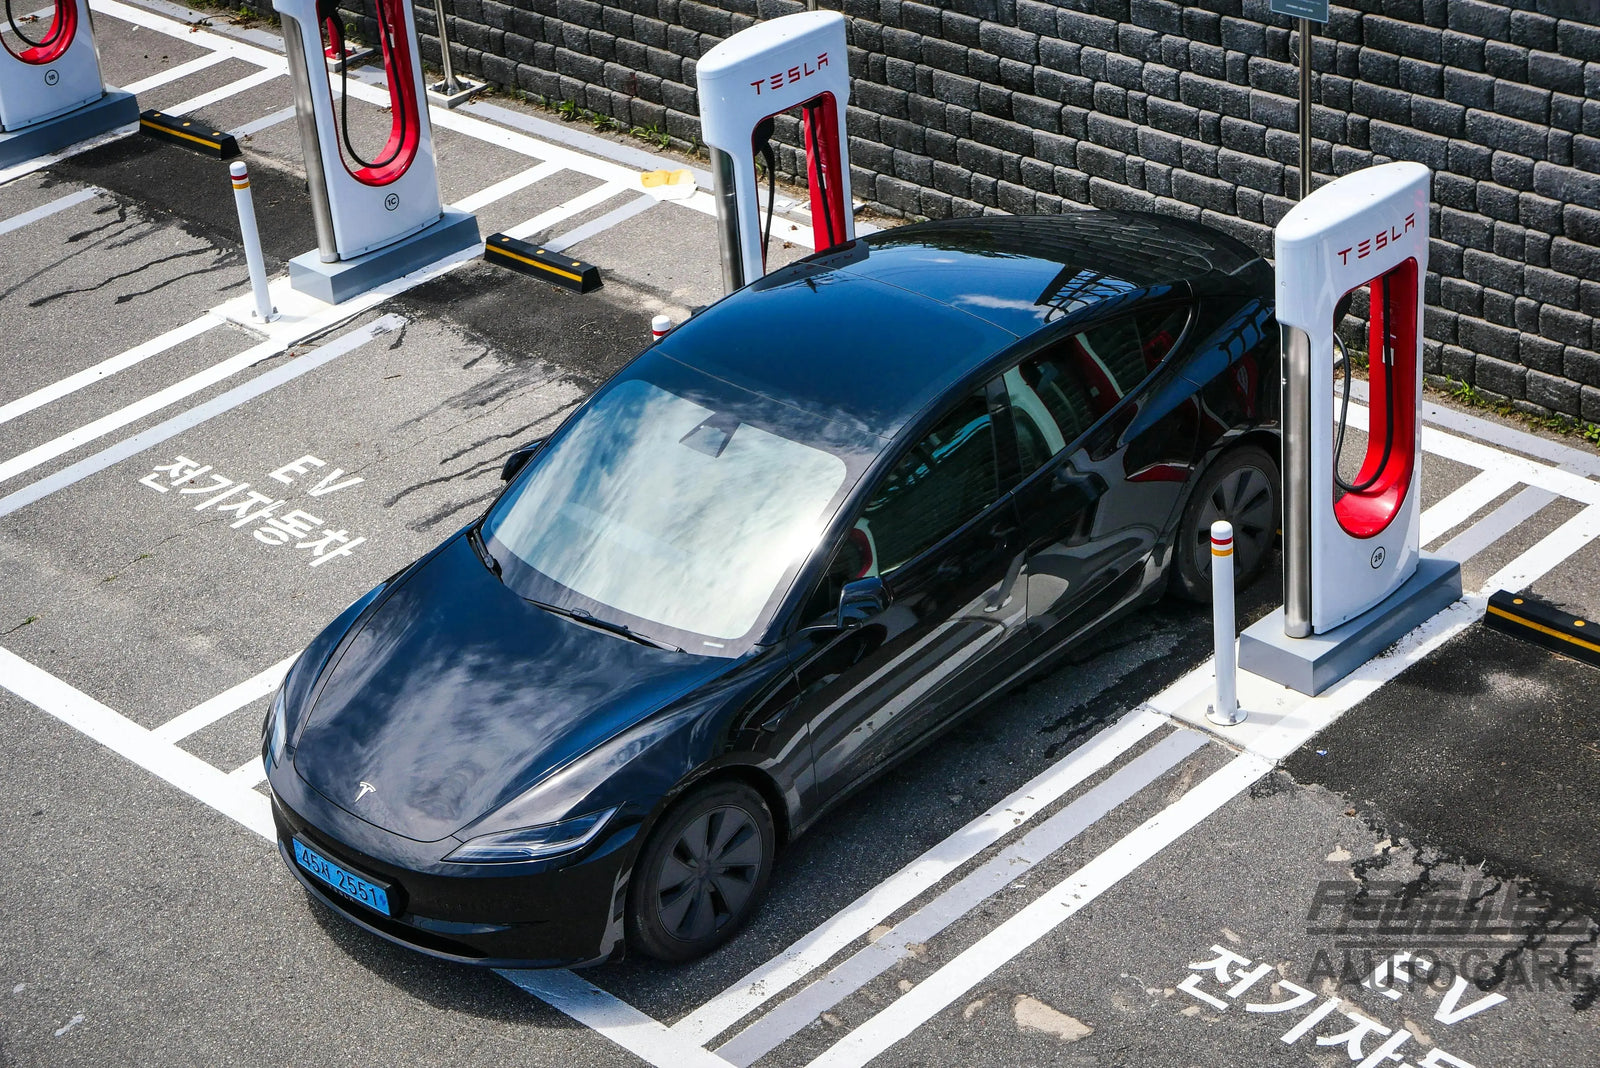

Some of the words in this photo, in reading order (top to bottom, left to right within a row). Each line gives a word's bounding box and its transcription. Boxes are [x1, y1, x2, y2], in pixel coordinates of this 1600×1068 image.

[750, 52, 828, 95] TESLA
[1337, 212, 1415, 266] TESLA
[267, 454, 365, 497] EV
[138, 455, 368, 568] 전기자동차
[336, 869, 377, 906] 2551
[1361, 952, 1508, 1025] EV
